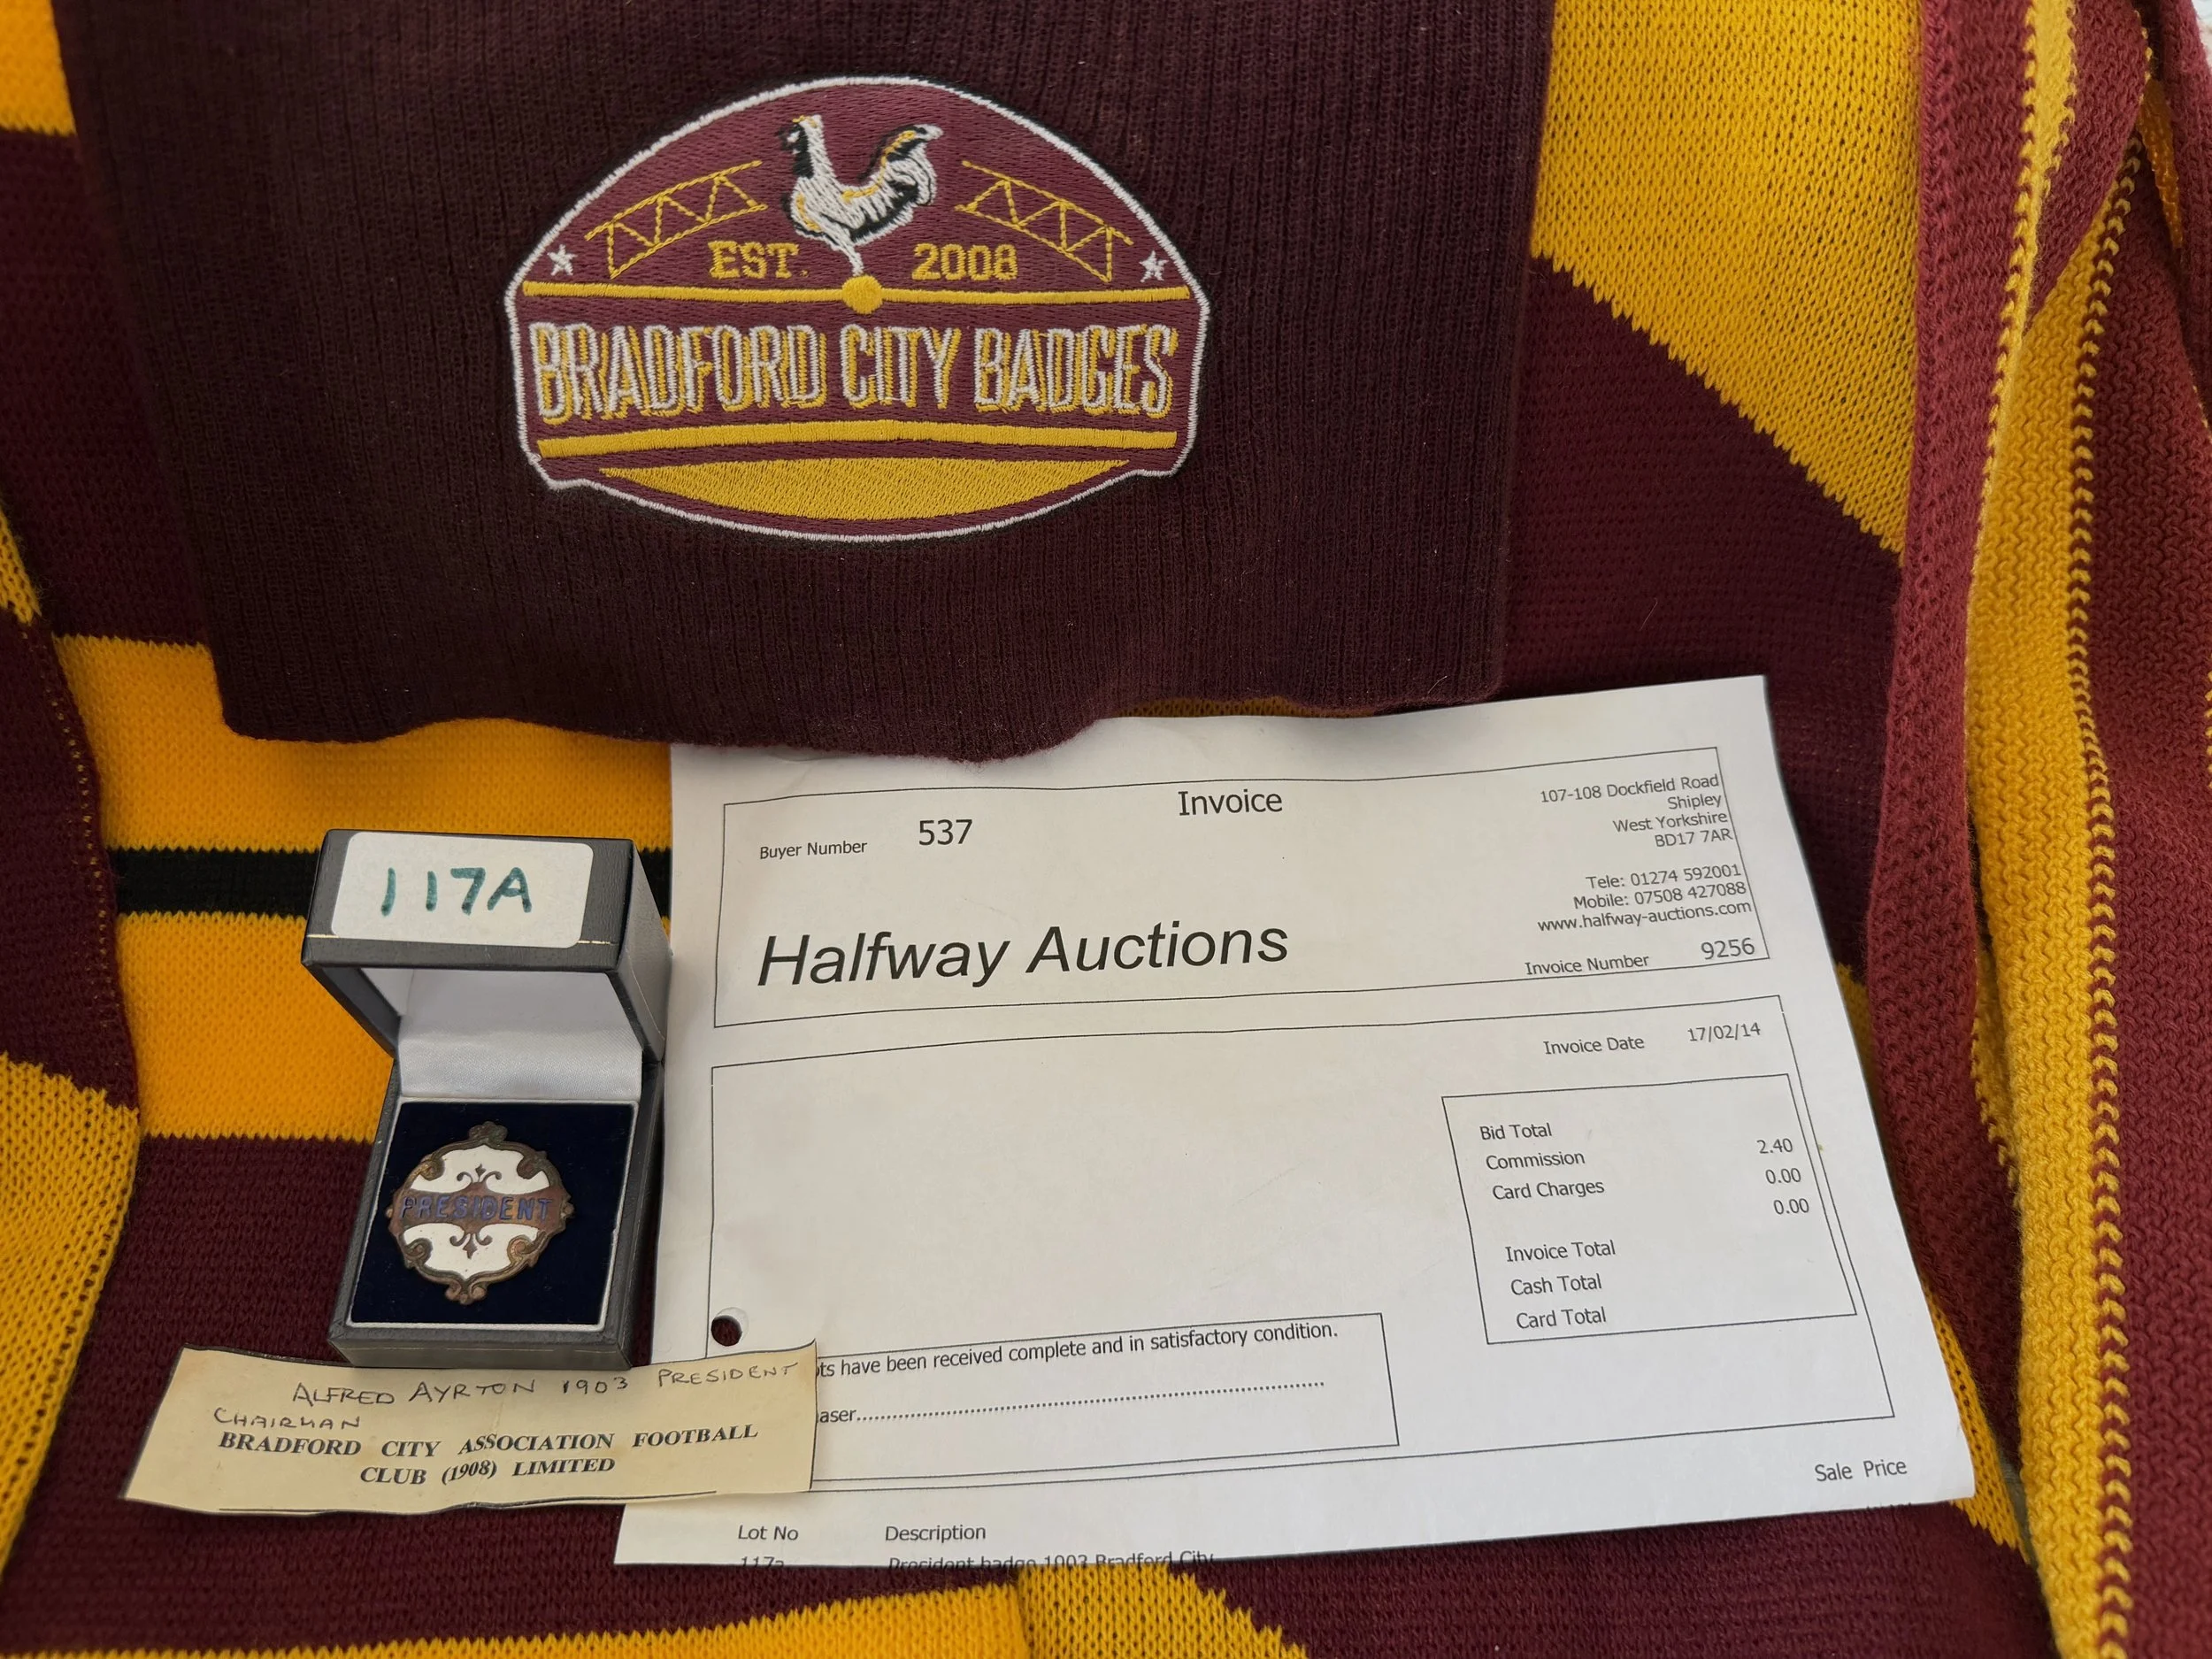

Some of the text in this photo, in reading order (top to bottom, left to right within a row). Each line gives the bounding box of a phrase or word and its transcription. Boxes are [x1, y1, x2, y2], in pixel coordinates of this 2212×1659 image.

[912, 242, 1018, 281] 2008
[531, 320, 1179, 425] BRADFORD CITY BADGES
[1540, 774, 1719, 803] 107-108 Dockfield Road
[1178, 790, 1283, 817] Invoice
[1667, 795, 1723, 810] Shipley
[918, 818, 973, 846] 537
[1612, 811, 1728, 833] West Yorkshire
[759, 839, 868, 860] Buyer Number
[1655, 828, 1733, 848] BD17 7AR
[1586, 864, 1741, 890] Tele: 01274 592001
[380, 866, 533, 917] 117A
[1573, 881, 1747, 910] Mobile: 07508 427088
[1537, 901, 1752, 932] www.halfway-auctions.com
[757, 919, 1288, 987] Halfway Auctions
[1701, 937, 1755, 960] 9256
[1525, 955, 1649, 975] Invoice Number
[1687, 1021, 1762, 1042] 17/02/14
[1543, 1036, 1646, 1056] Invoice Date
[1479, 1122, 1553, 1141] Bid Total
[1756, 1138, 1793, 1155] 2.40
[1486, 1150, 1586, 1171] Commission
[1764, 1167, 1801, 1185] 0.00
[1492, 1179, 1605, 1201] Card Charges
[399, 1194, 558, 1223] PRESIDENT
[1773, 1197, 1809, 1216] 0.00
[1504, 1239, 1617, 1263] Invoice Total
[1510, 1273, 1602, 1296] Cash Total
[1516, 1306, 1607, 1329] Card Total
[817, 1322, 1338, 1378] ts have been received complete and in satisfactory condition.
[292, 1382, 395, 1407] ALFRED
[562, 1376, 628, 1395] 1903
[658, 1362, 798, 1386] PRESIDENT
[218, 1424, 759, 1457] BRADFORD CITY ASSOCIATION FOOTBALL
[359, 1457, 616, 1486] CLUB (1908) LIMITED
[1815, 1459, 1908, 1482] Sale Price
[738, 1525, 799, 1541] Lot No
[885, 1525, 986, 1544] Description
